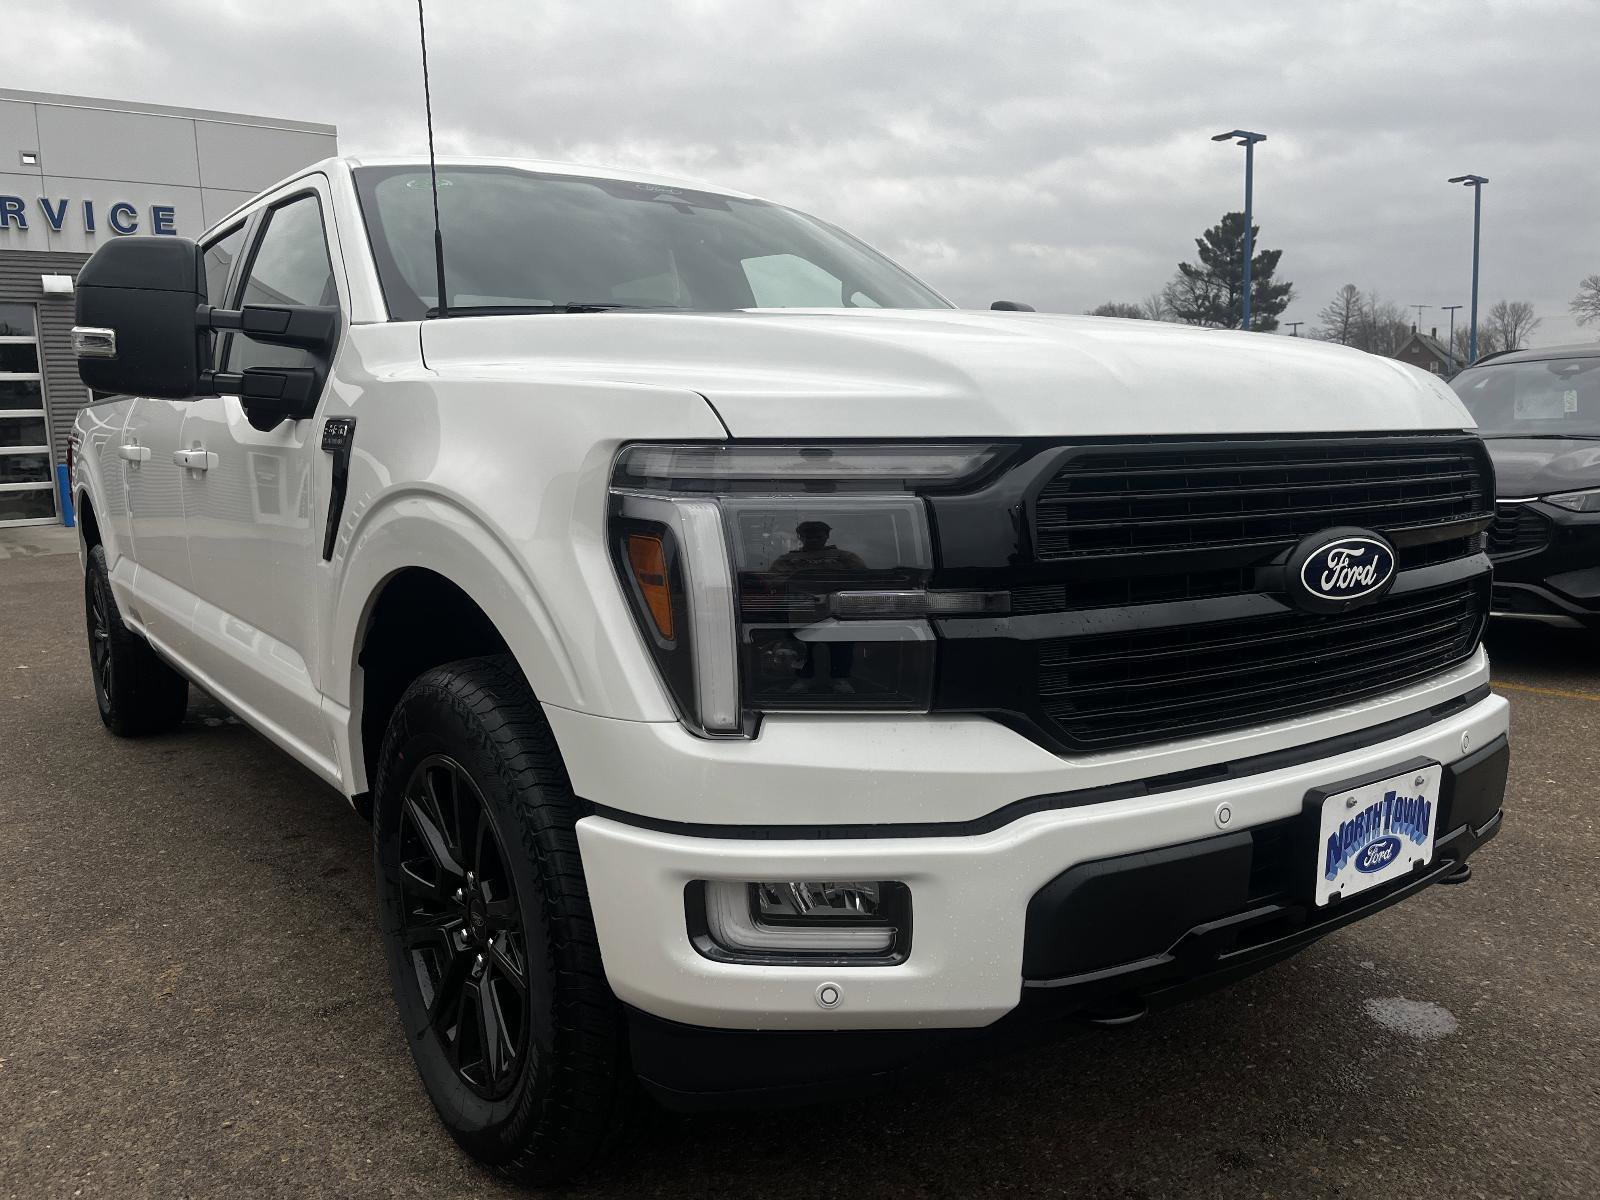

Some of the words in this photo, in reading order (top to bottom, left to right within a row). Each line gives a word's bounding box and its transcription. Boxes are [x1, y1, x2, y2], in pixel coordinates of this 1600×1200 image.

[0, 195, 177, 236] RVICE
[1321, 548, 1378, 590] Ford
[1364, 841, 1393, 867] Ford
